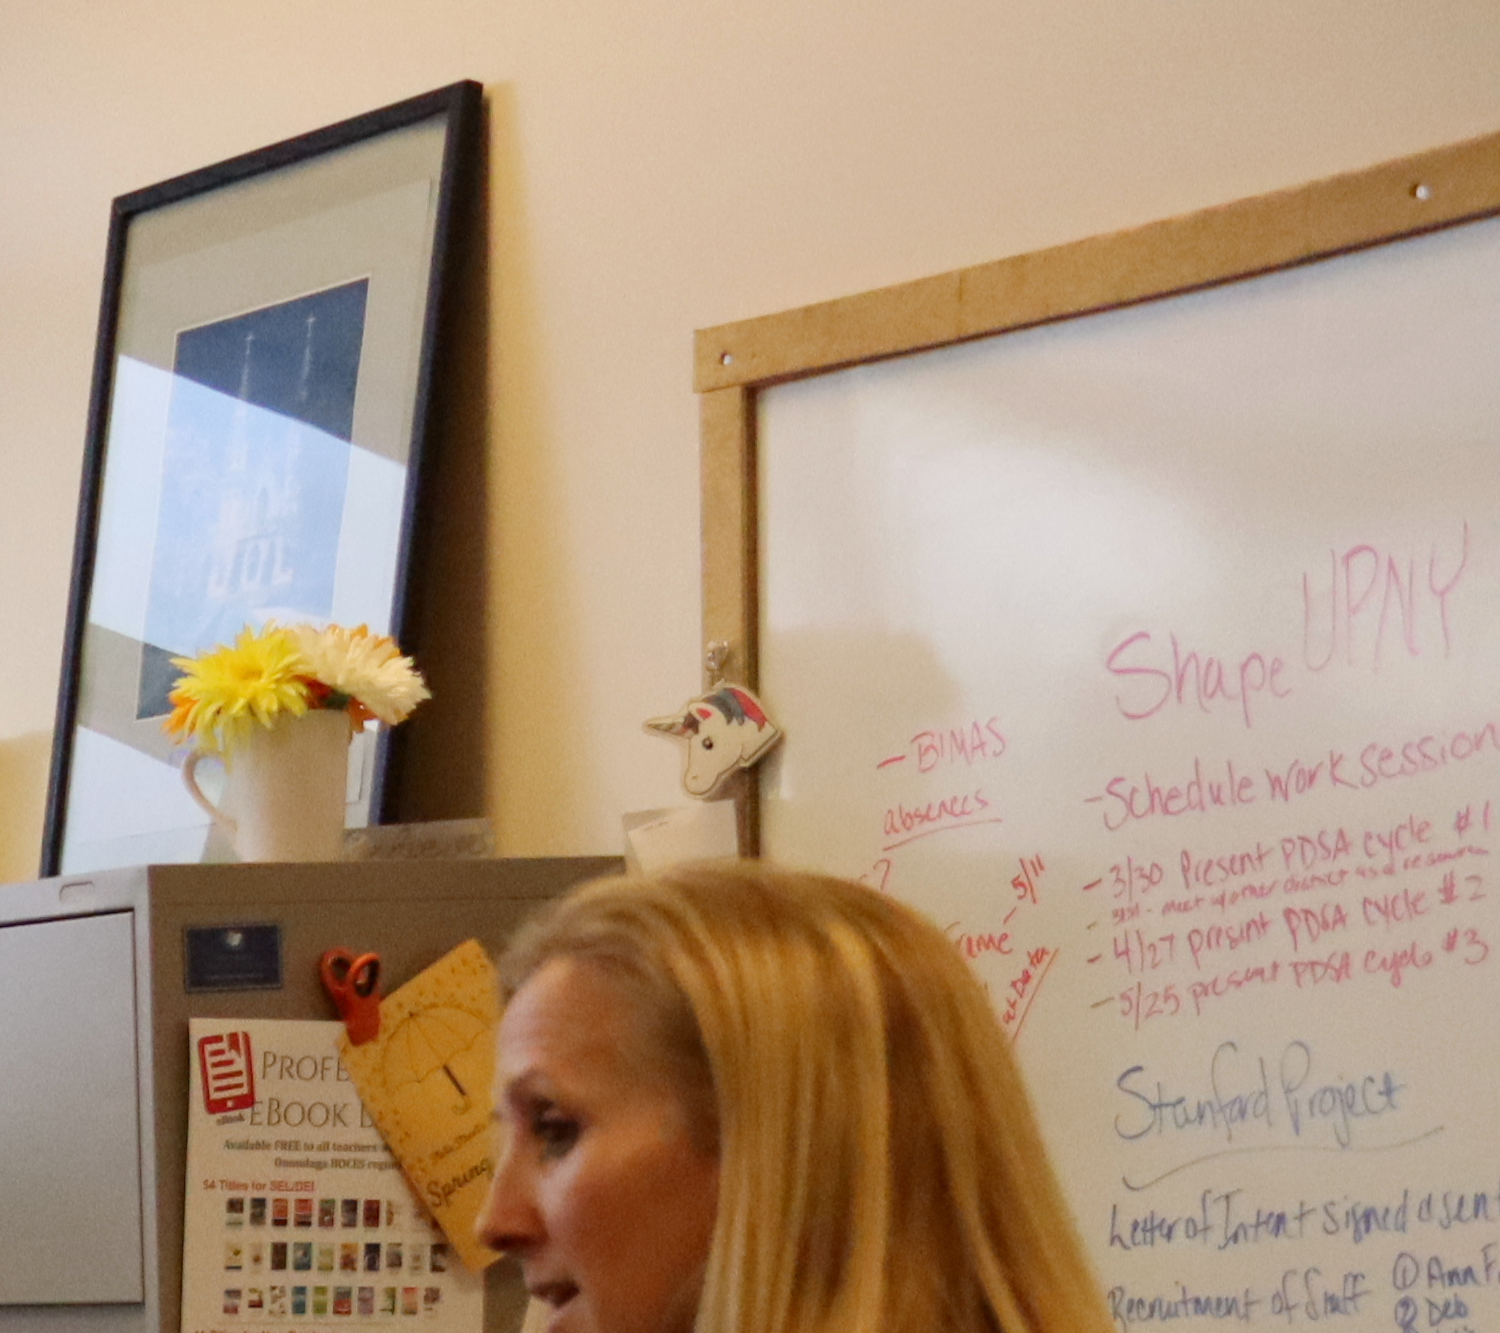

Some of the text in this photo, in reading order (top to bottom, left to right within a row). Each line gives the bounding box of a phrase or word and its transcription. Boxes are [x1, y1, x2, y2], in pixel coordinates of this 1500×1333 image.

[1105, 630, 1294, 729] Shape
[1109, 855, 1164, 902] 3/30
[1280, 827, 1352, 871] PDSA
[1112, 929, 1176, 974] 4/27
[1283, 903, 1348, 953] PDSA
[1119, 981, 1180, 1031] 5/25
[261, 1050, 350, 1082] PROFE
[1279, 1040, 1406, 1149] Project
[274, 1139, 301, 1152] FREE
[251, 1180, 266, 1192] for
[1108, 1203, 1178, 1251] Letter
[1184, 1189, 1212, 1244] of
[1212, 1188, 1317, 1251] Intent
